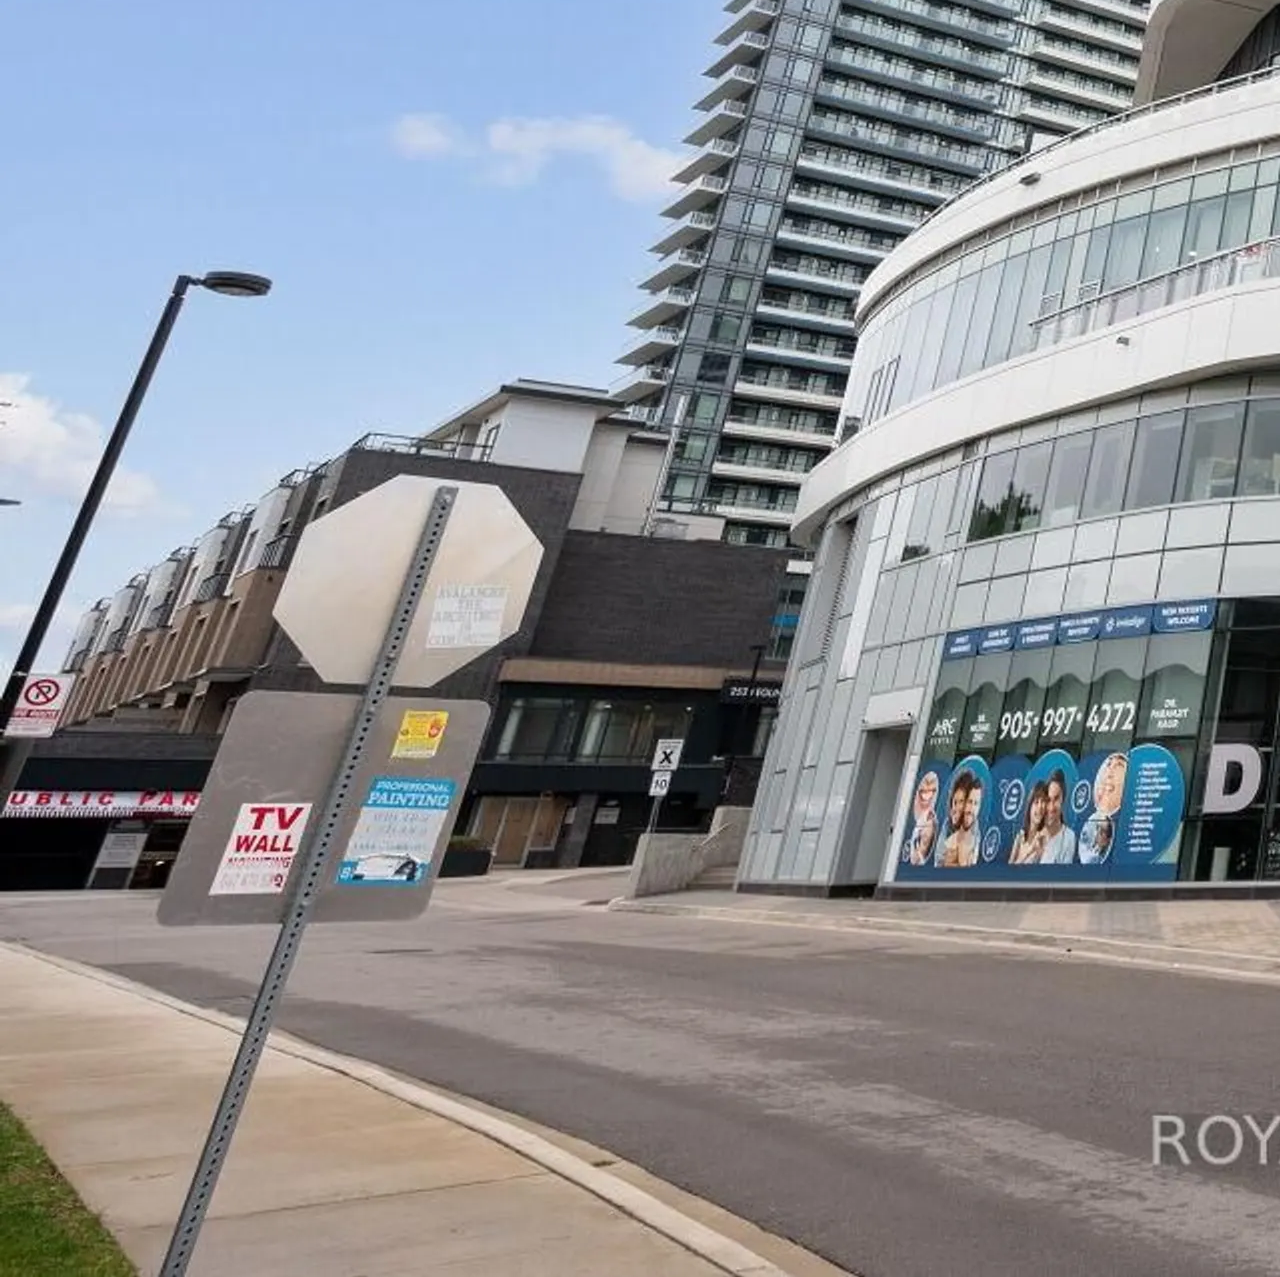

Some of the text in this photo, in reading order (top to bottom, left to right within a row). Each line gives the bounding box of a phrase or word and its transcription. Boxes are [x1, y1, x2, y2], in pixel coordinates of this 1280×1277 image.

[1087, 701, 1135, 732] 4272
[9, 792, 114, 805] UBLIC
[368, 792, 450, 807] PAINTING
[250, 807, 304, 830] TV
[235, 834, 293, 852] WALL
